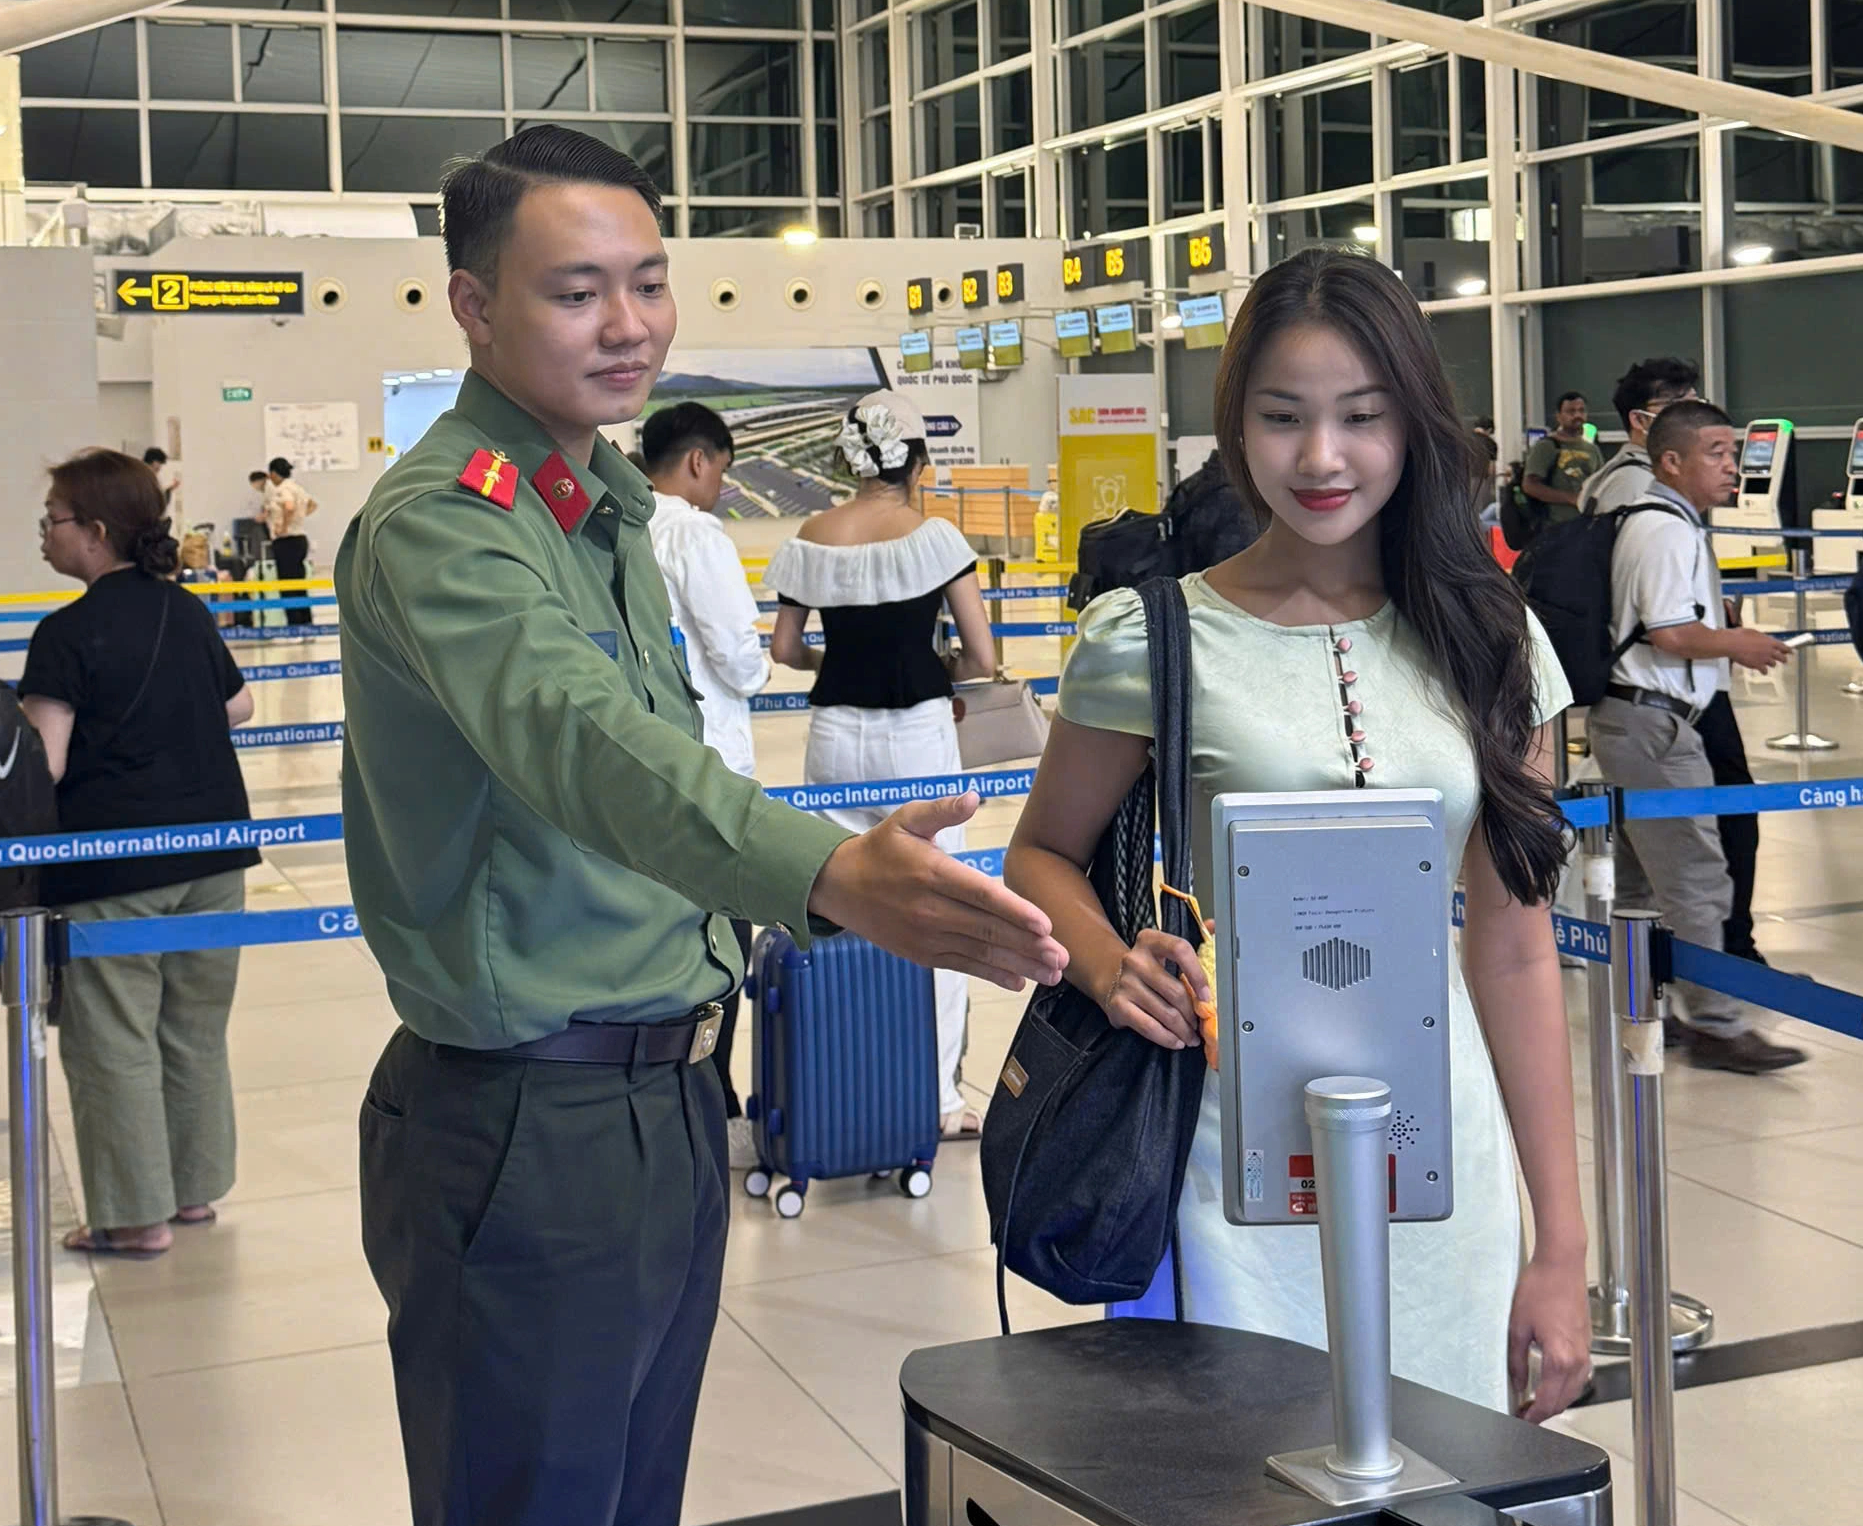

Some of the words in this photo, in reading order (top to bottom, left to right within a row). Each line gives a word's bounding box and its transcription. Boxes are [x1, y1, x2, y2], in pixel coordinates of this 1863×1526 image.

[1105, 248, 1125, 277] B5
[1189, 236, 1212, 268] B6
[997, 270, 1013, 297] B3
[1063, 257, 1082, 285] B4
[161, 280, 181, 304] 2
[962, 277, 977, 303] B2
[785, 696, 807, 708] Qu
[231, 725, 331, 746] nternational
[968, 774, 1031, 795] Airport
[1800, 787, 1847, 807] Cảng
[225, 823, 305, 846] Airport
[1555, 917, 1566, 945] ế
[1569, 925, 1608, 955] Phú
